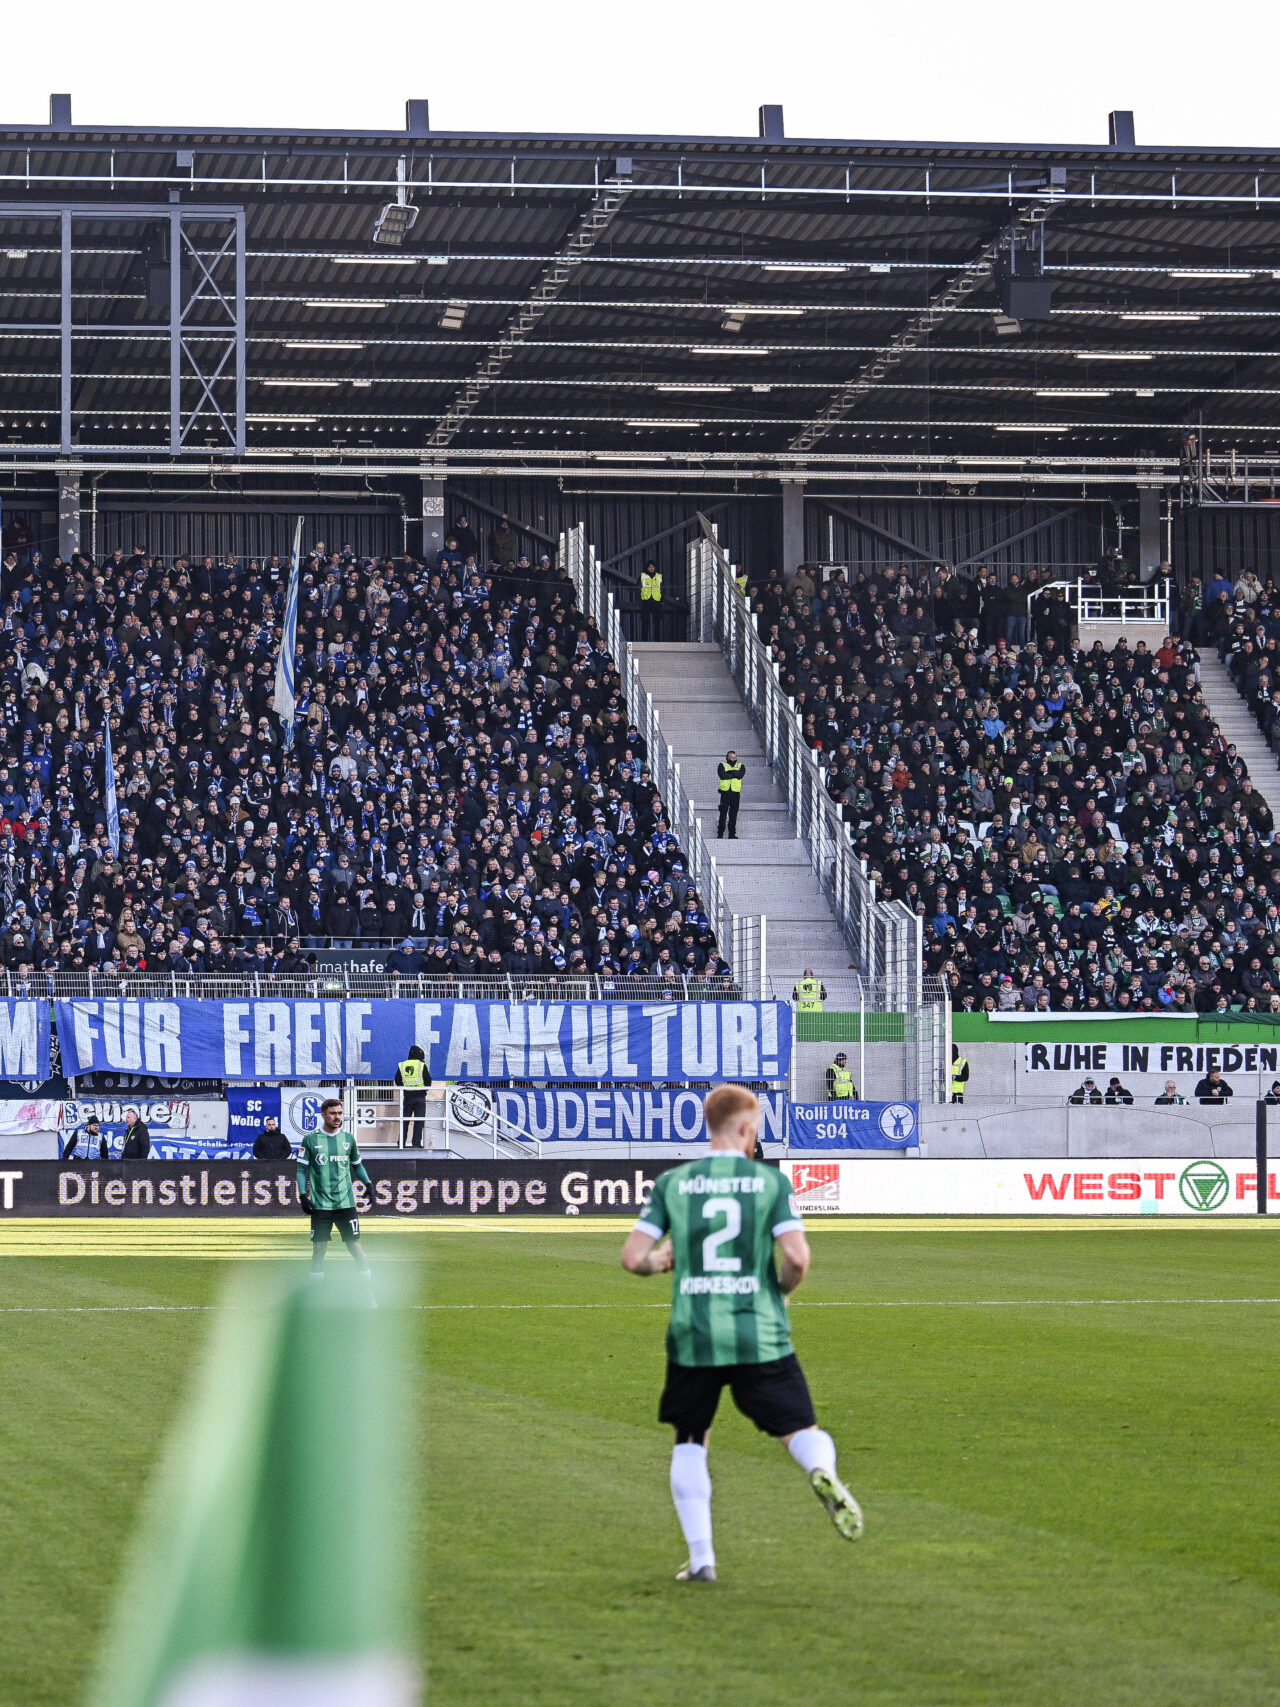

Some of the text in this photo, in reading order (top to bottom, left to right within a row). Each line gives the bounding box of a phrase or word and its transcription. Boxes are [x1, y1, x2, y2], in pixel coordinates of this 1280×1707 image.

[315, 959, 388, 973] imathafe
[802, 1001, 815, 1009] 347
[223, 1001, 372, 1076] FREIE
[414, 1001, 780, 1078] FANKULTUR!
[1031, 1043, 1278, 1072] RUHE IN FRIEDEN
[247, 1100, 262, 1111] SC
[500, 1089, 784, 1140] DUDENHON
[795, 1106, 870, 1121] Rolli Ultra
[231, 1115, 261, 1127] Wolle
[816, 1123, 848, 1139] S04
[58, 1170, 548, 1213] Dienstleistgsgruppe
[561, 1170, 657, 1206] Gmb
[679, 1174, 766, 1195] MÜNSTER
[1023, 1173, 1176, 1200] WEST
[702, 1197, 742, 1272] 2
